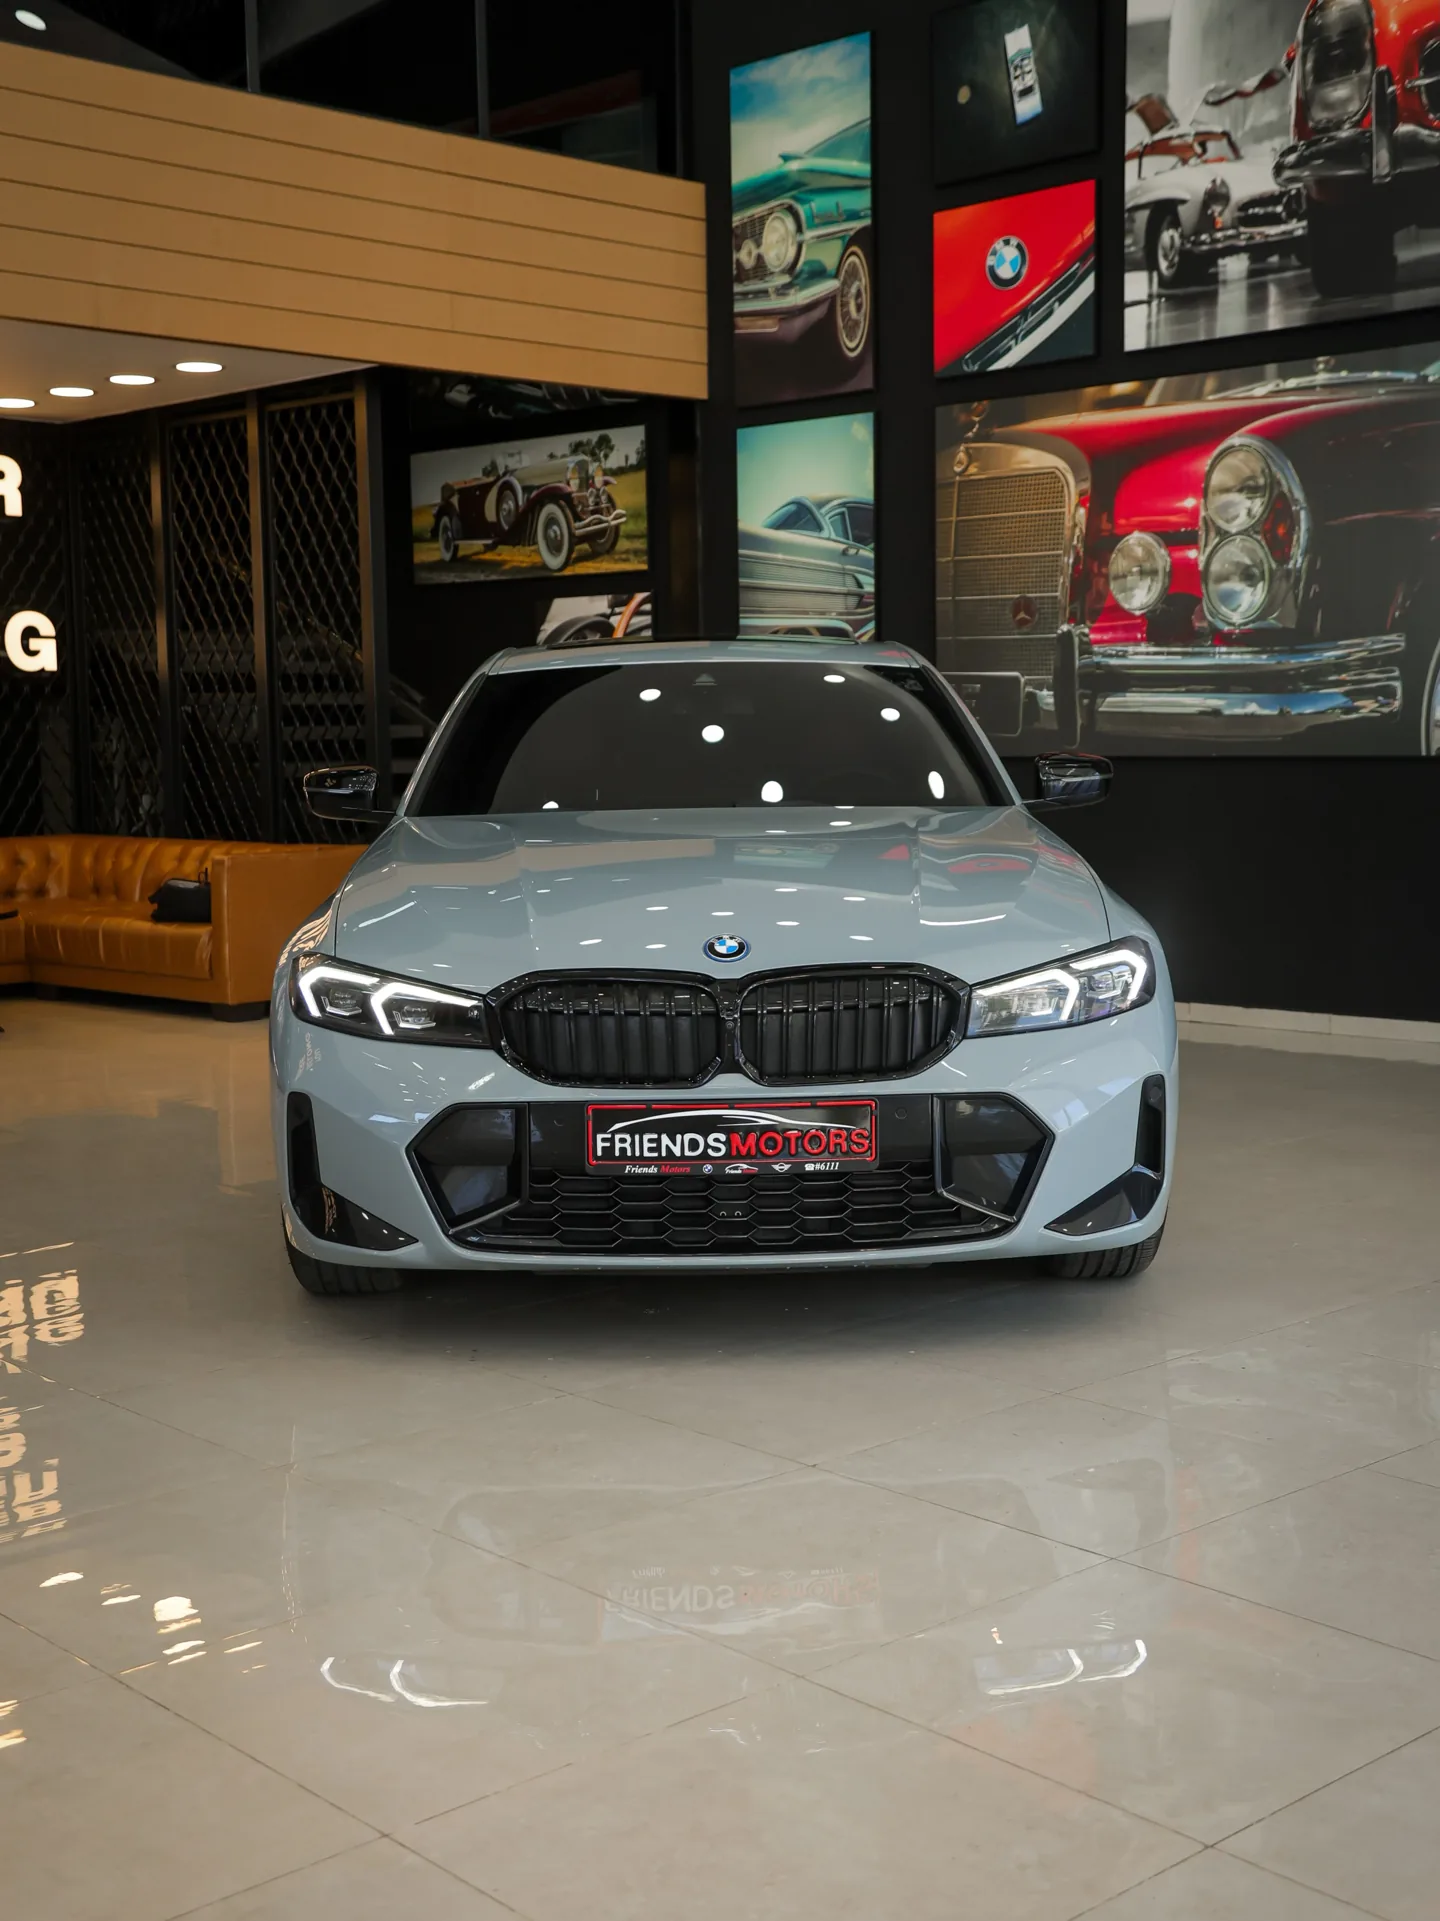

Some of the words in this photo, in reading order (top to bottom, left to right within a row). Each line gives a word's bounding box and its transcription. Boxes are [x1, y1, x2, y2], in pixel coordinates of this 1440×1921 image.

[4, 610, 58, 672] G
[596, 1132, 727, 1157] FRIENDS
[729, 1128, 869, 1157] MOTORS
[624, 1165, 658, 1174] Friends
[659, 1165, 691, 1174] Motors
